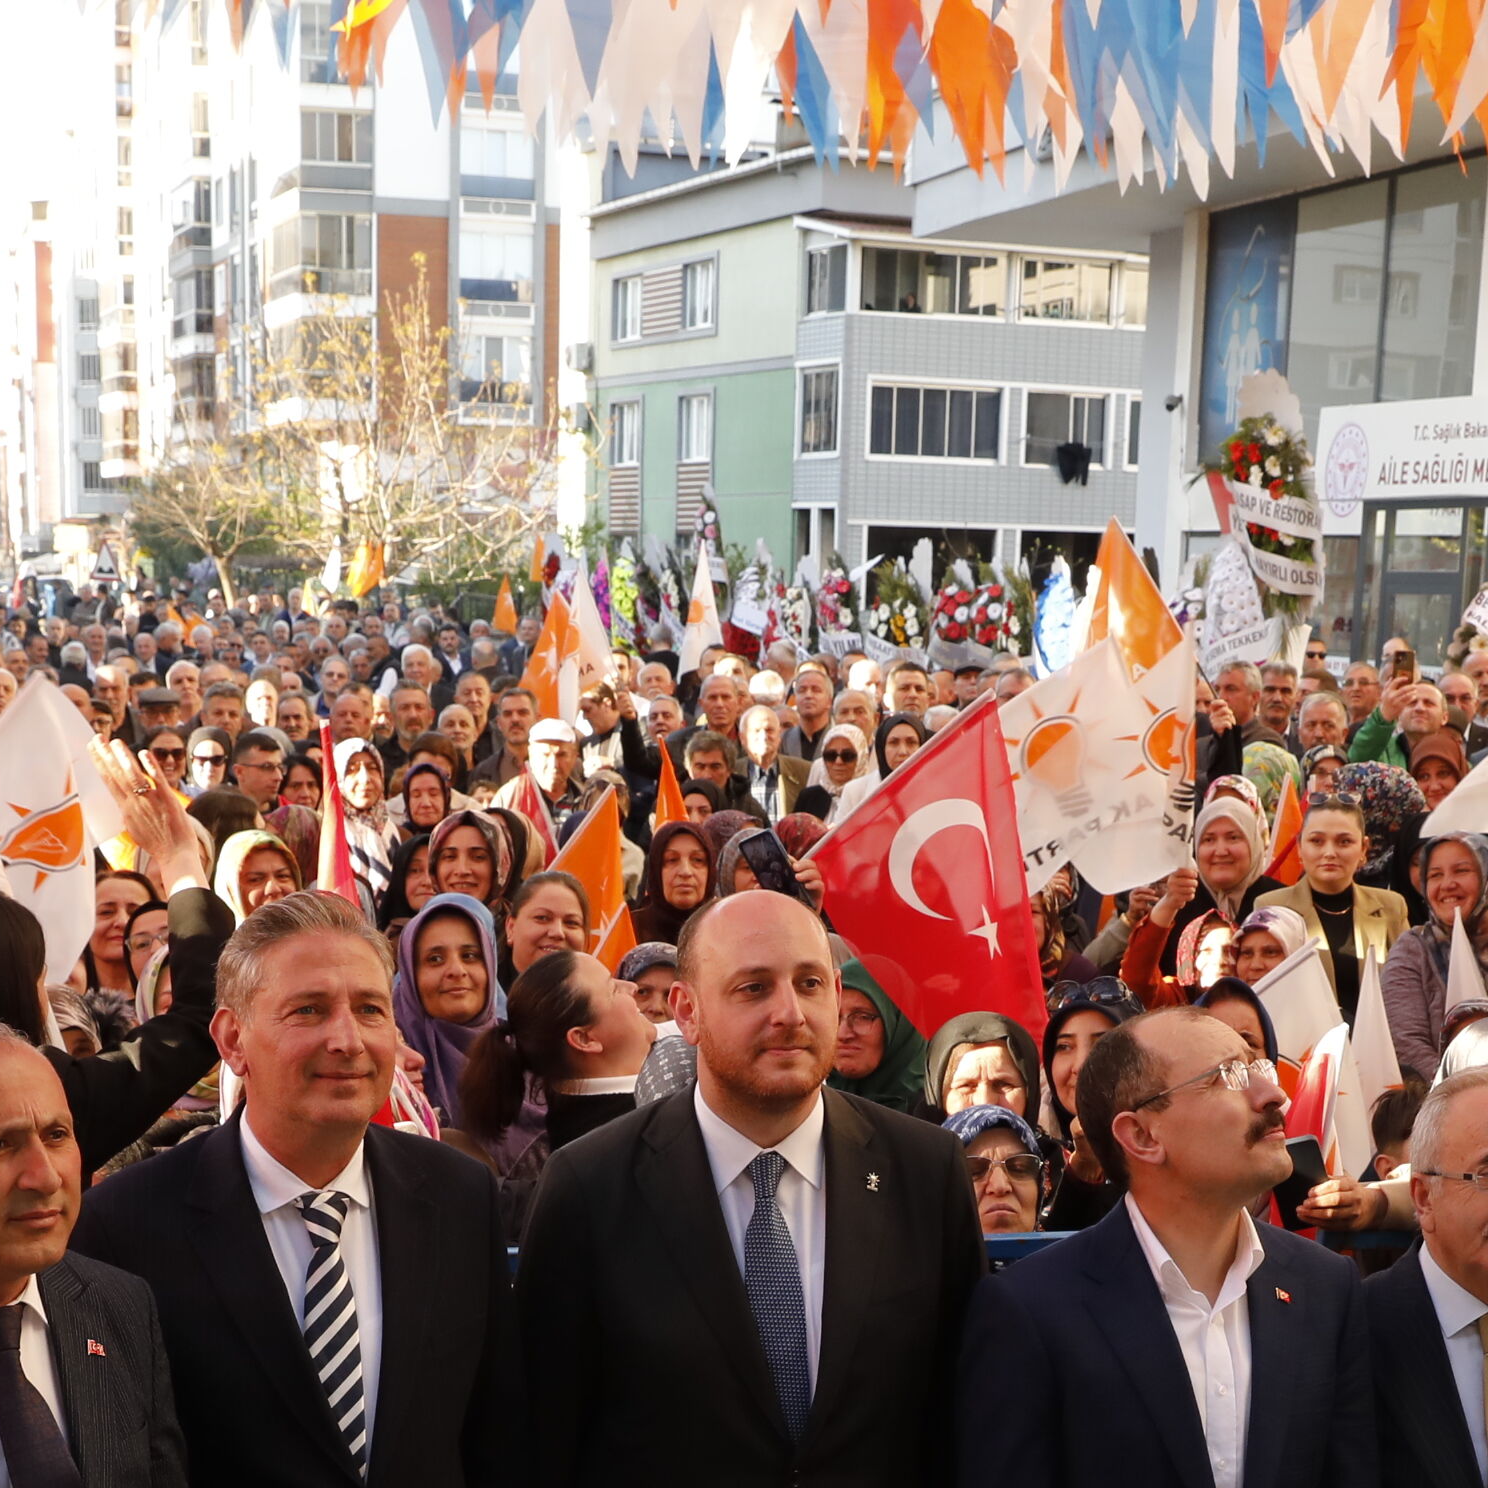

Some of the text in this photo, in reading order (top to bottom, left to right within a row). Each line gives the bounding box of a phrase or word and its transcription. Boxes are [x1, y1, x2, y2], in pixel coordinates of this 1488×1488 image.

[1414, 424, 1431, 441] T.C.
[1433, 423, 1462, 444] Sağlık
[1377, 454, 1410, 486] AİLE
[1411, 453, 1468, 484] SAĞLIĞI
[1259, 499, 1272, 517] VE
